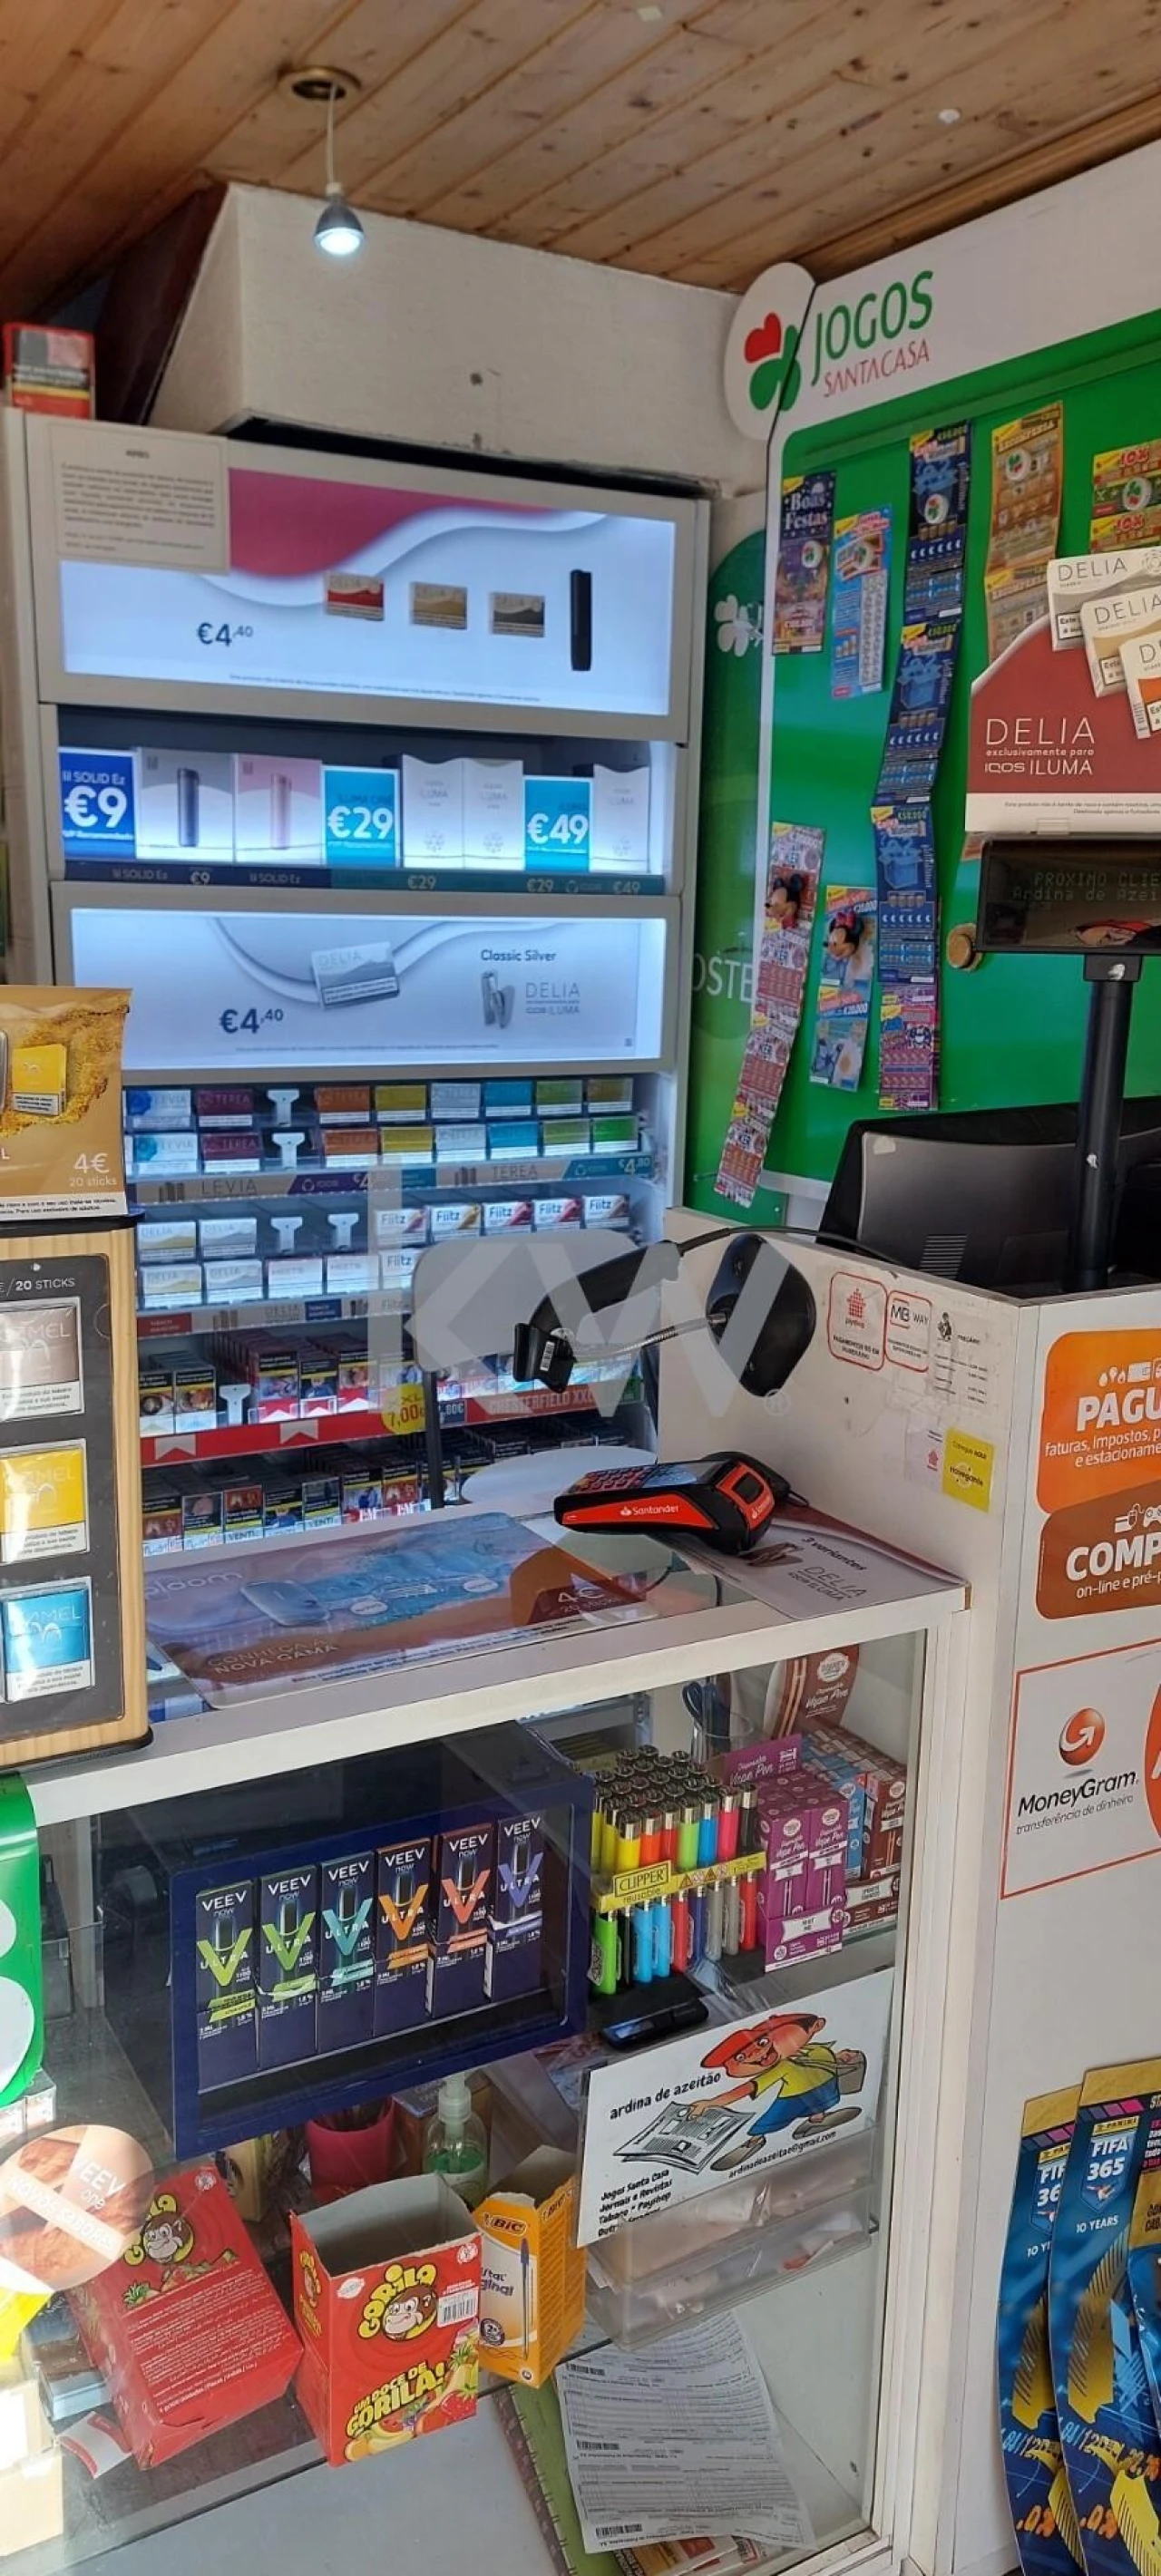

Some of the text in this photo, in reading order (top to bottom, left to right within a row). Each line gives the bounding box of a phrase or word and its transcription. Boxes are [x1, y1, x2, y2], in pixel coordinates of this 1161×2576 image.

[811, 270, 933, 386] JOGOS
[790, 492, 826, 510] Boas
[785, 511, 828, 530] Festas
[1058, 558, 1127, 582] DELIA
[1094, 594, 1161, 625] DELIA
[986, 717, 1095, 745] DELIA
[986, 748, 1095, 759] exclusivamente para
[984, 760, 1093, 775] IQOS ILUMA
[73, 771, 110, 785] SOLID
[63, 785, 127, 829] €9
[327, 806, 394, 840] €29
[527, 813, 590, 845] €49
[190, 870, 211, 886] €9
[408, 875, 437, 890] €29
[527, 880, 554, 893] €29
[612, 880, 641, 894] €49
[1012, 886, 1074, 900] Ardina
[1086, 888, 1106, 900] de
[481, 949, 557, 962] Classic Silver
[525, 982, 580, 998] DELIA
[74, 1153, 110, 1173] 4€
[492, 1164, 538, 1179] TEREA
[87, 1175, 117, 1187] sticks
[202, 1180, 258, 1196] LEVIA
[35, 1278, 75, 1289] STICKS
[891, 1304, 930, 1325] MB WAY
[491, 1390, 570, 1414] CHESTERFIELD
[1093, 1429, 1151, 1448] impostos,
[1075, 1456, 1083, 1467] e
[632, 1505, 679, 1516] Santander
[812, 1542, 868, 1570] variantes
[804, 1567, 867, 1597] DELIA
[1077, 1578, 1120, 1599] on-line
[1123, 1577, 1131, 1589] e
[214, 1645, 338, 1674] NOVA GAMA
[755, 1763, 774, 1778] Pen
[1017, 1770, 1137, 1816] MoneyGram
[1016, 1794, 1134, 1835] transferência de dinheiro
[504, 1817, 541, 1836] VEEV
[450, 1833, 488, 1852] VEEV
[385, 1848, 425, 1867] VEEV
[328, 1861, 370, 1882] VEEV
[620, 1864, 666, 1892] CLIPPER
[268, 1874, 311, 1896] VEEV
[202, 1891, 247, 1911] VEEV
[610, 2072, 721, 2120] ardina de azeitão
[1091, 2136, 1128, 2158] FIFA
[651, 2170, 669, 2182] Casa
[1087, 2157, 1126, 2182] 365
[599, 2209, 629, 2224] Tabaco
[638, 2192, 672, 2211] Payshop
[600, 2197, 630, 2212] Jornais
[493, 2218, 525, 2232] BIC
[1077, 2215, 1119, 2234] 10 YEARS
[372, 2372, 408, 2398] DOCE
[409, 2360, 428, 2379] DE
[346, 2362, 445, 2438] GORILA!
